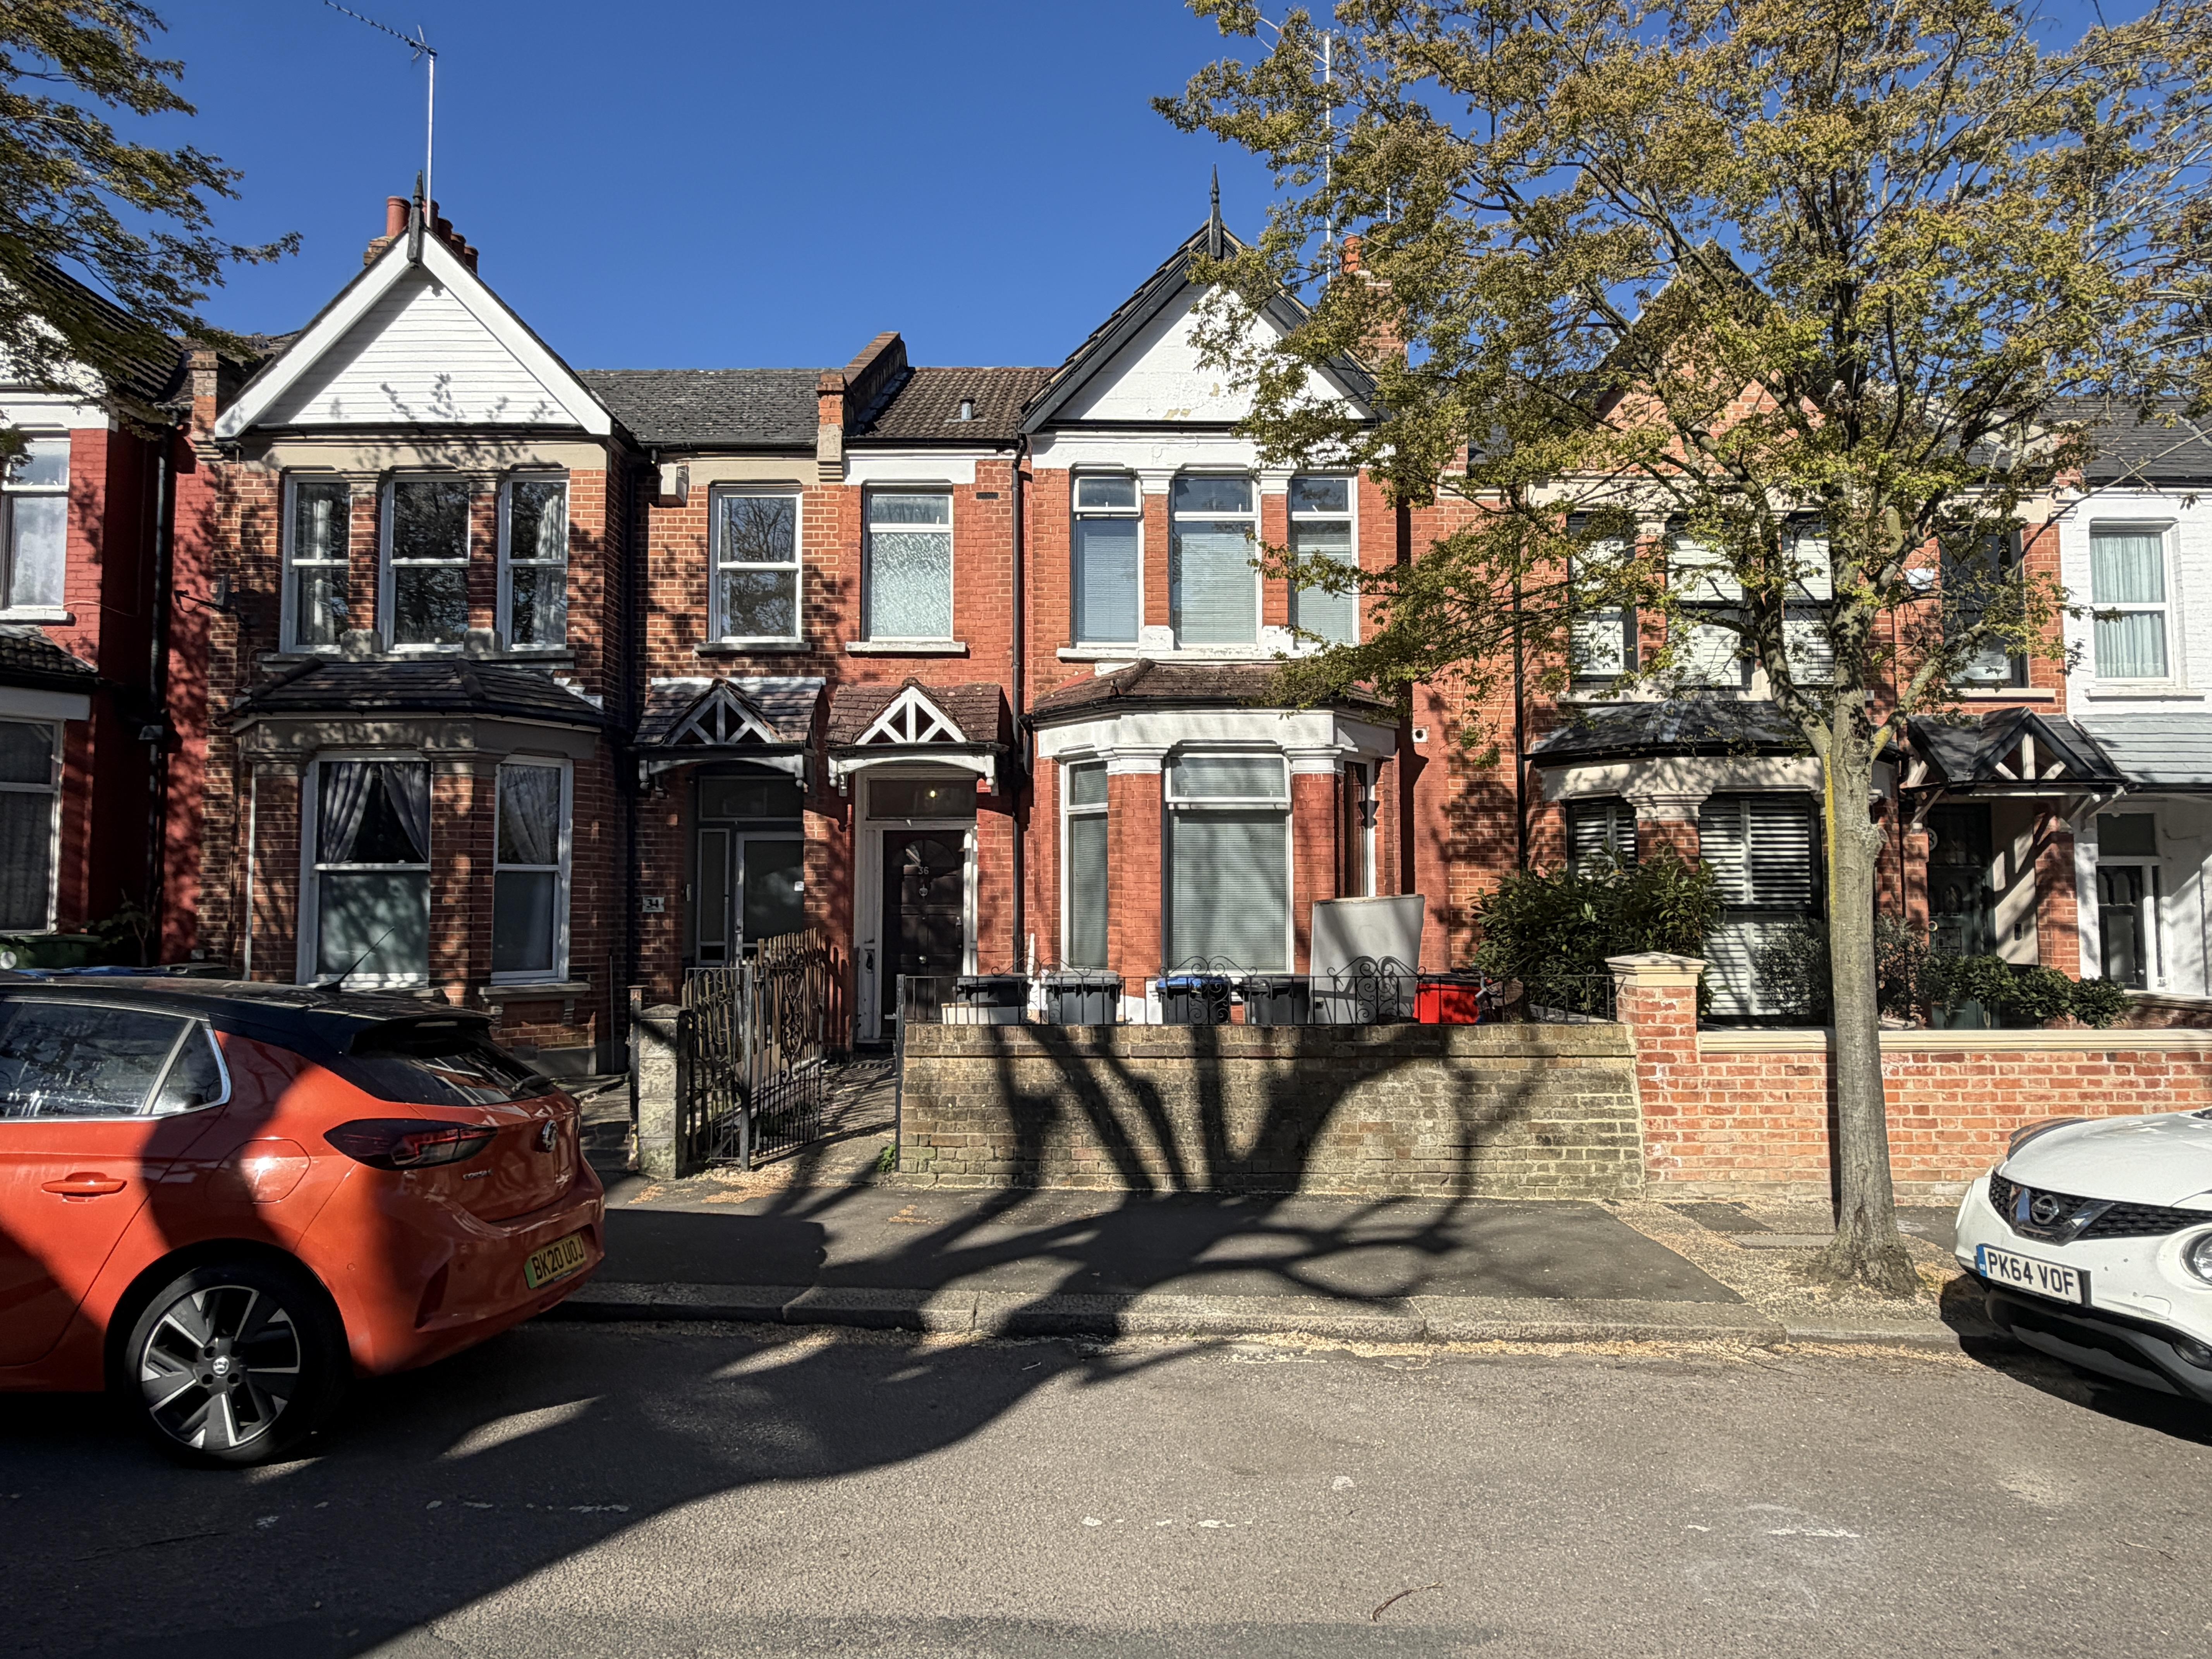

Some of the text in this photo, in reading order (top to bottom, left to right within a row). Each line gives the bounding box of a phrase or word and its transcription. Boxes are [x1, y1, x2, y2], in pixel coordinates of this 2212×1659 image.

[918, 866, 929, 874] 36
[646, 899, 659, 908] 34
[531, 1237, 584, 1280] BK20 UOJ
[1987, 1252, 2074, 1295] PK64 VOF
